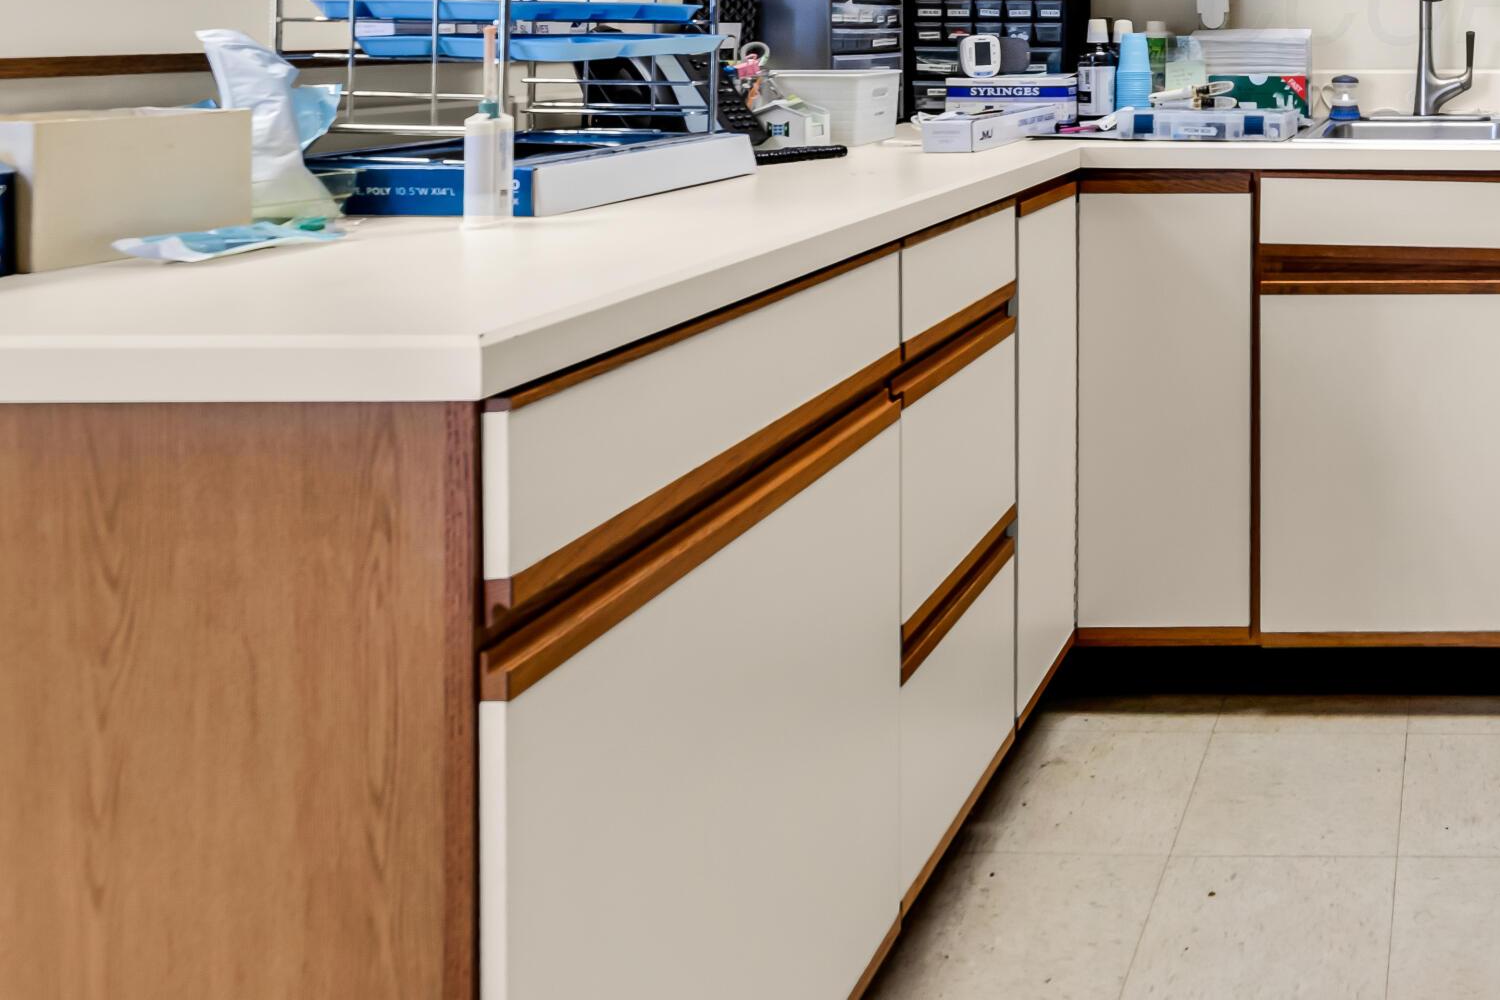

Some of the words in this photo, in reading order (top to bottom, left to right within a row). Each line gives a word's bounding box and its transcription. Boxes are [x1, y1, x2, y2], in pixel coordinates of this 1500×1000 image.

[1287, 77, 1303, 93] FAST
[969, 87, 1041, 97] SYRINGES
[366, 187, 392, 196] POLY
